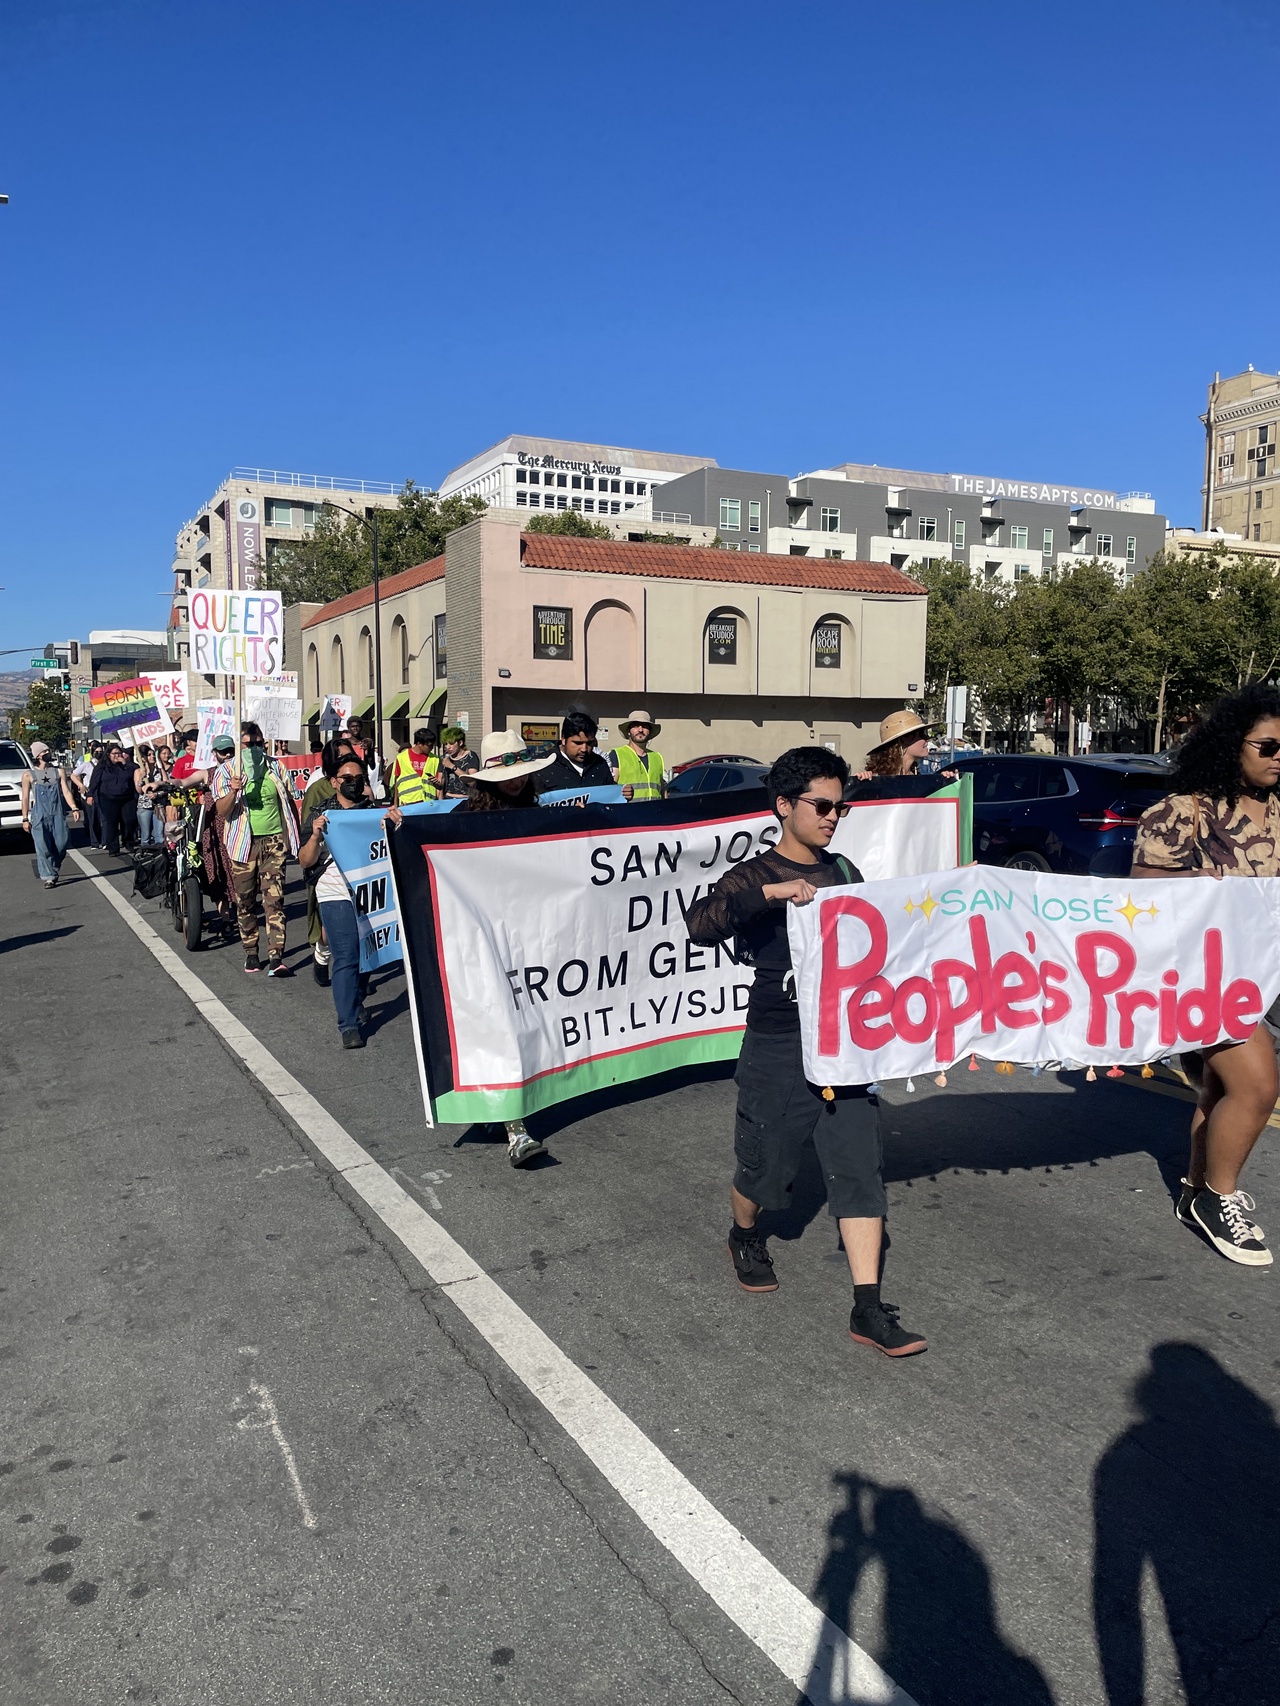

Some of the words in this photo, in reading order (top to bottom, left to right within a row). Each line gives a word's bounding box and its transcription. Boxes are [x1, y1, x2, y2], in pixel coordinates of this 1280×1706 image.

[517, 451, 540, 468] The
[542, 454, 591, 476] Mercury
[592, 460, 622, 475] News
[243, 527, 254, 562] NOW
[244, 566, 256, 591] LEA
[192, 592, 280, 635] QUEER
[539, 624, 565, 646] TIME
[710, 631, 735, 640] STUDIOS
[816, 629, 839, 639] ESCAPE
[816, 638, 839, 649] ROOM
[195, 633, 279, 675] RIGHTS
[103, 684, 145, 707] BORN
[252, 698, 274, 710] OUT
[136, 721, 166, 739] KIDS
[370, 840, 388, 860] SH
[589, 840, 682, 887] SAN
[699, 825, 778, 869] JOS
[940, 889, 1013, 916] SAN
[505, 949, 629, 1011] FROM
[648, 937, 740, 979] GEN
[817, 895, 1072, 1064] People's
[1075, 927, 1264, 1050] Pride
[561, 983, 750, 1048] BIT.LY/SJD
